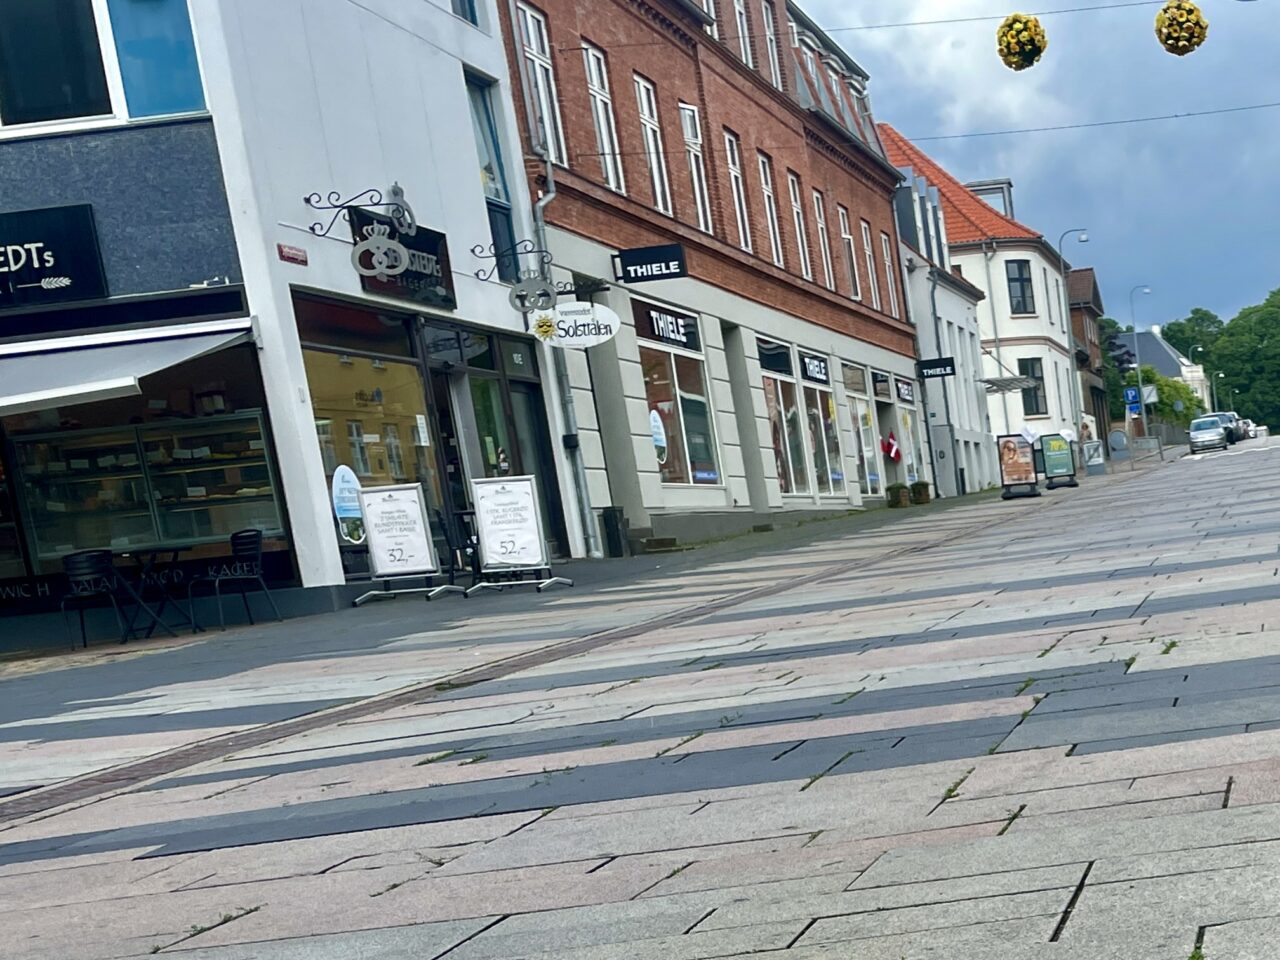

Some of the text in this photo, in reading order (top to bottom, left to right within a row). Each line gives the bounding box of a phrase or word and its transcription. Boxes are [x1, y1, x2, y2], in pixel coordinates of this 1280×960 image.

[627, 261, 680, 278] THIELE
[556, 317, 613, 338] Solstrålen
[650, 310, 687, 343] THIELE
[804, 357, 827, 381] THIELE
[922, 366, 953, 377] THIELE
[1127, 390, 1136, 401] P
[499, 540, 527, 555] 52,-
[387, 548, 415, 564] 32,-
